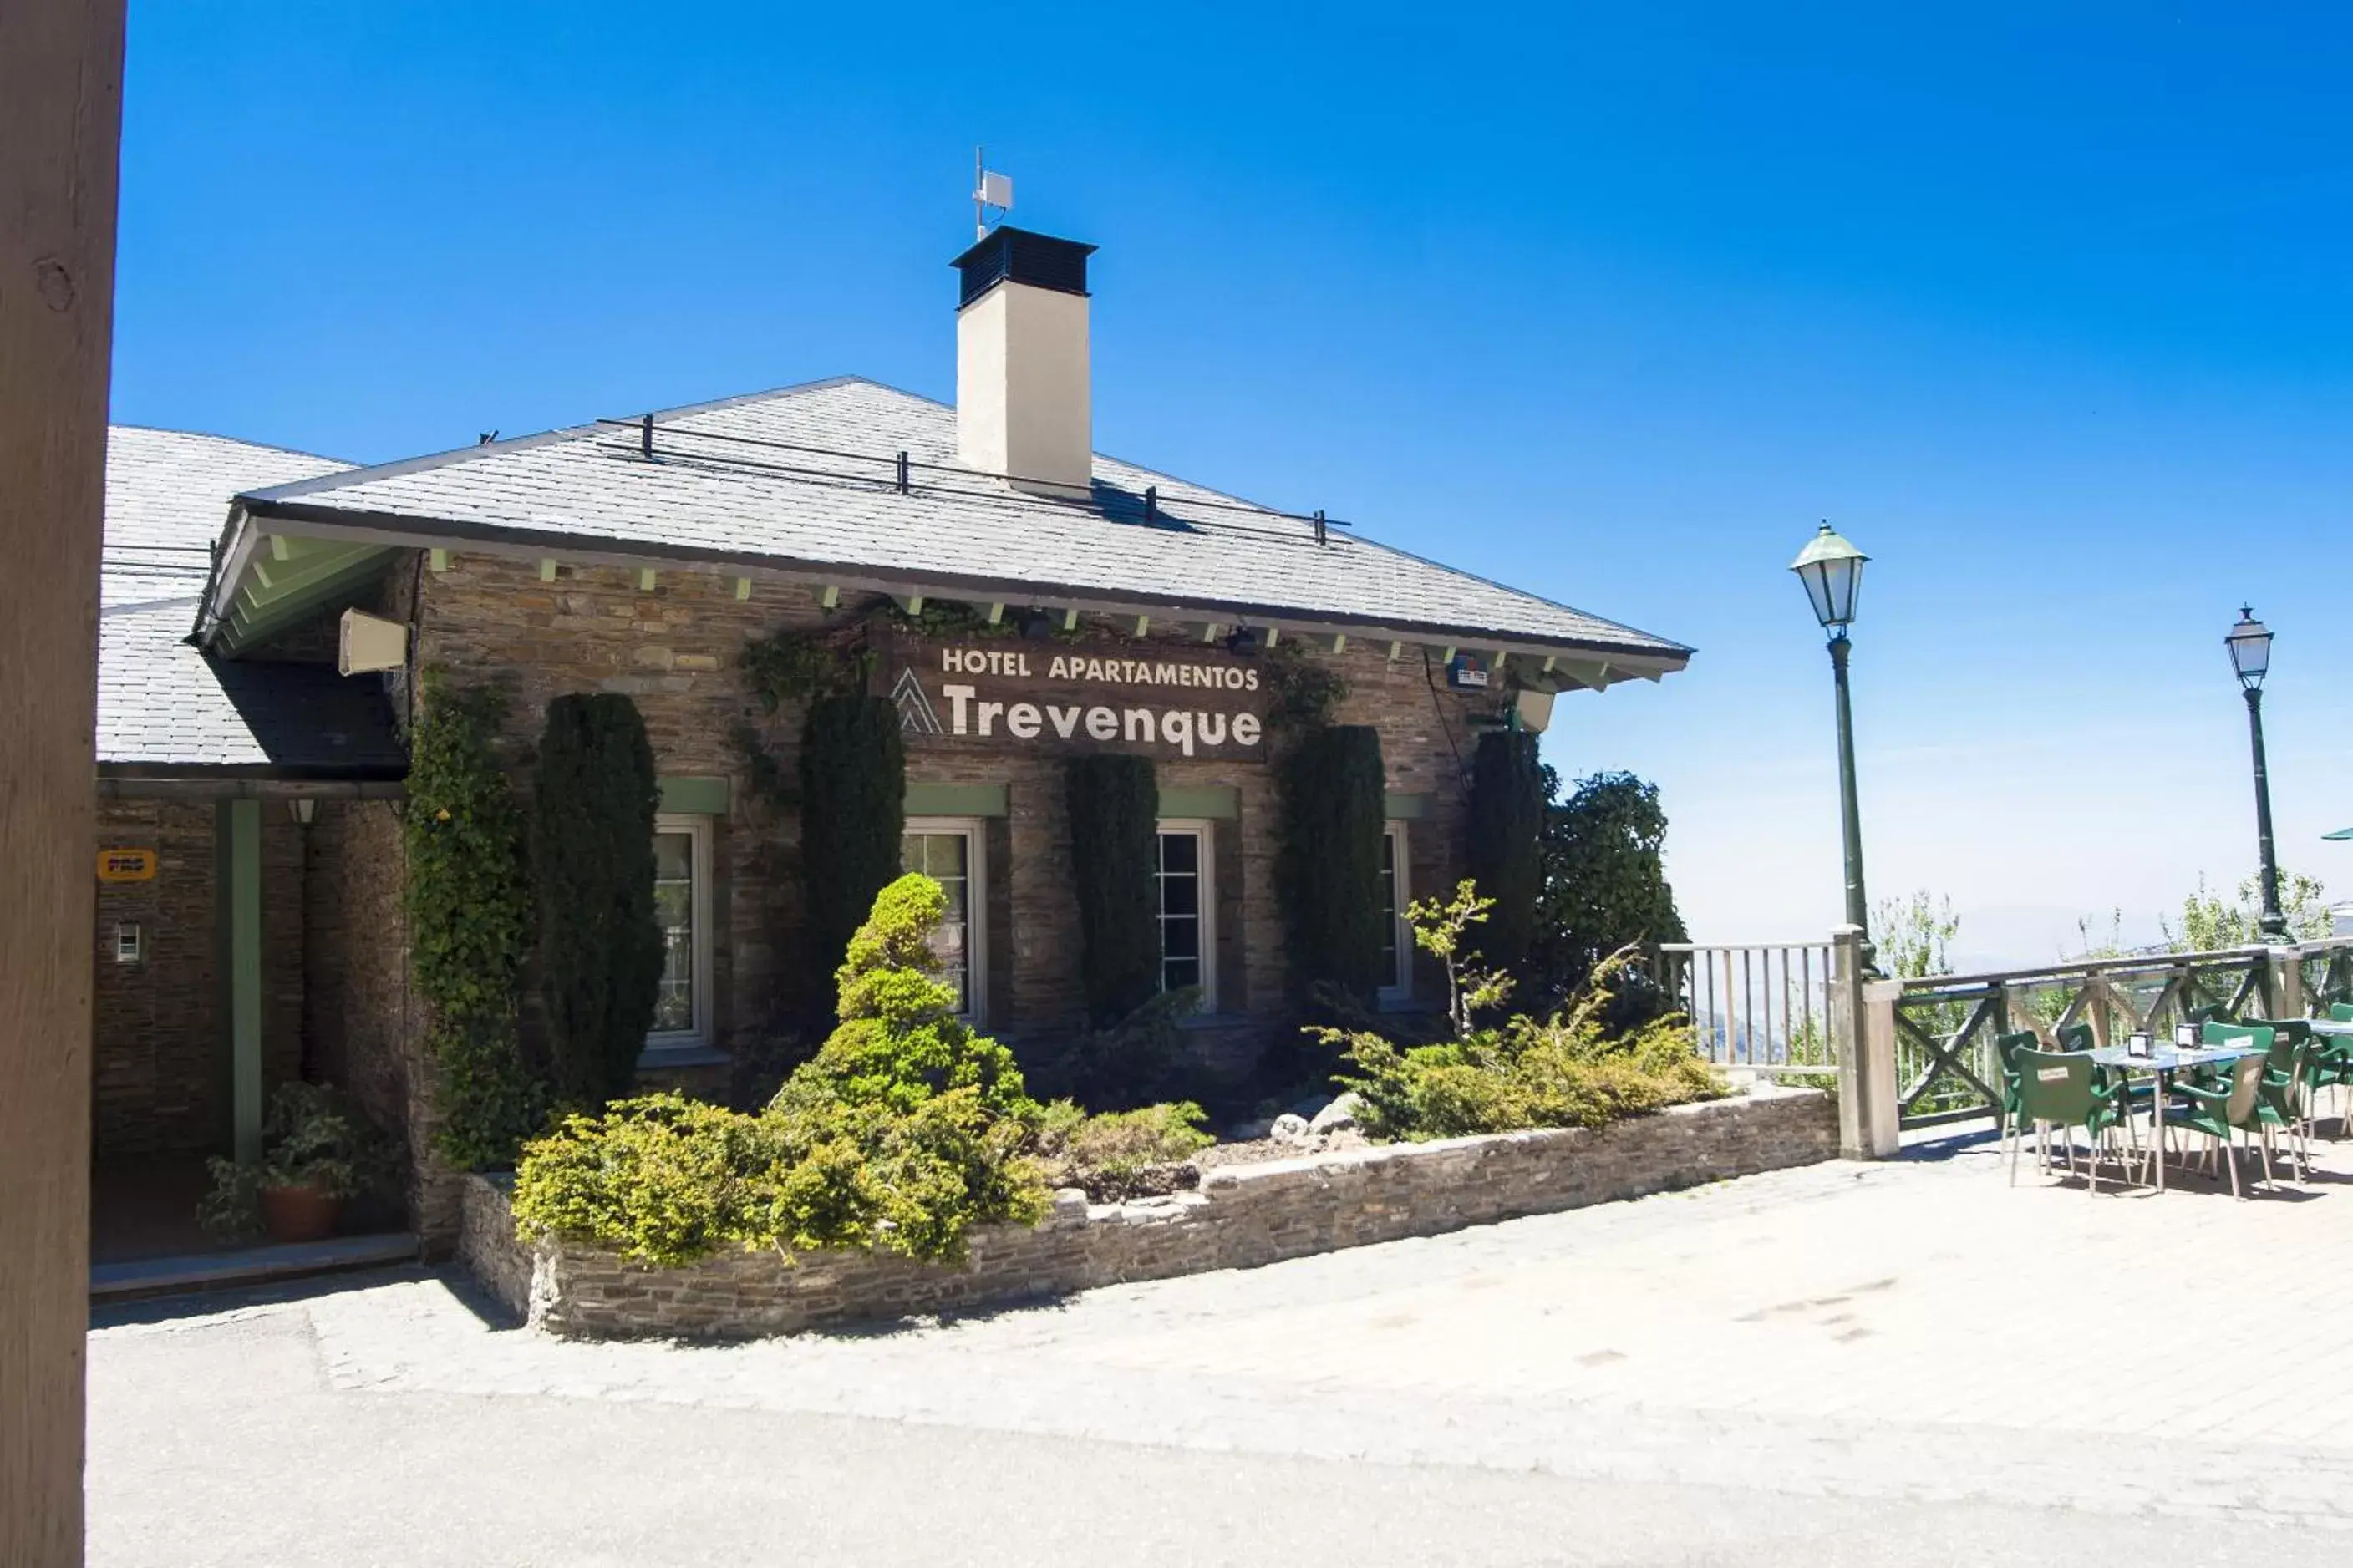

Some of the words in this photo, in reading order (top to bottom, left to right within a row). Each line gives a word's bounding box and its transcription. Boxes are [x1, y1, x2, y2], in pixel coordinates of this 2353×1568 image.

[942, 648, 1032, 677] HOTEL
[1049, 656, 1259, 691] APARTAMENTOS
[943, 684, 1261, 757] Trevenque
